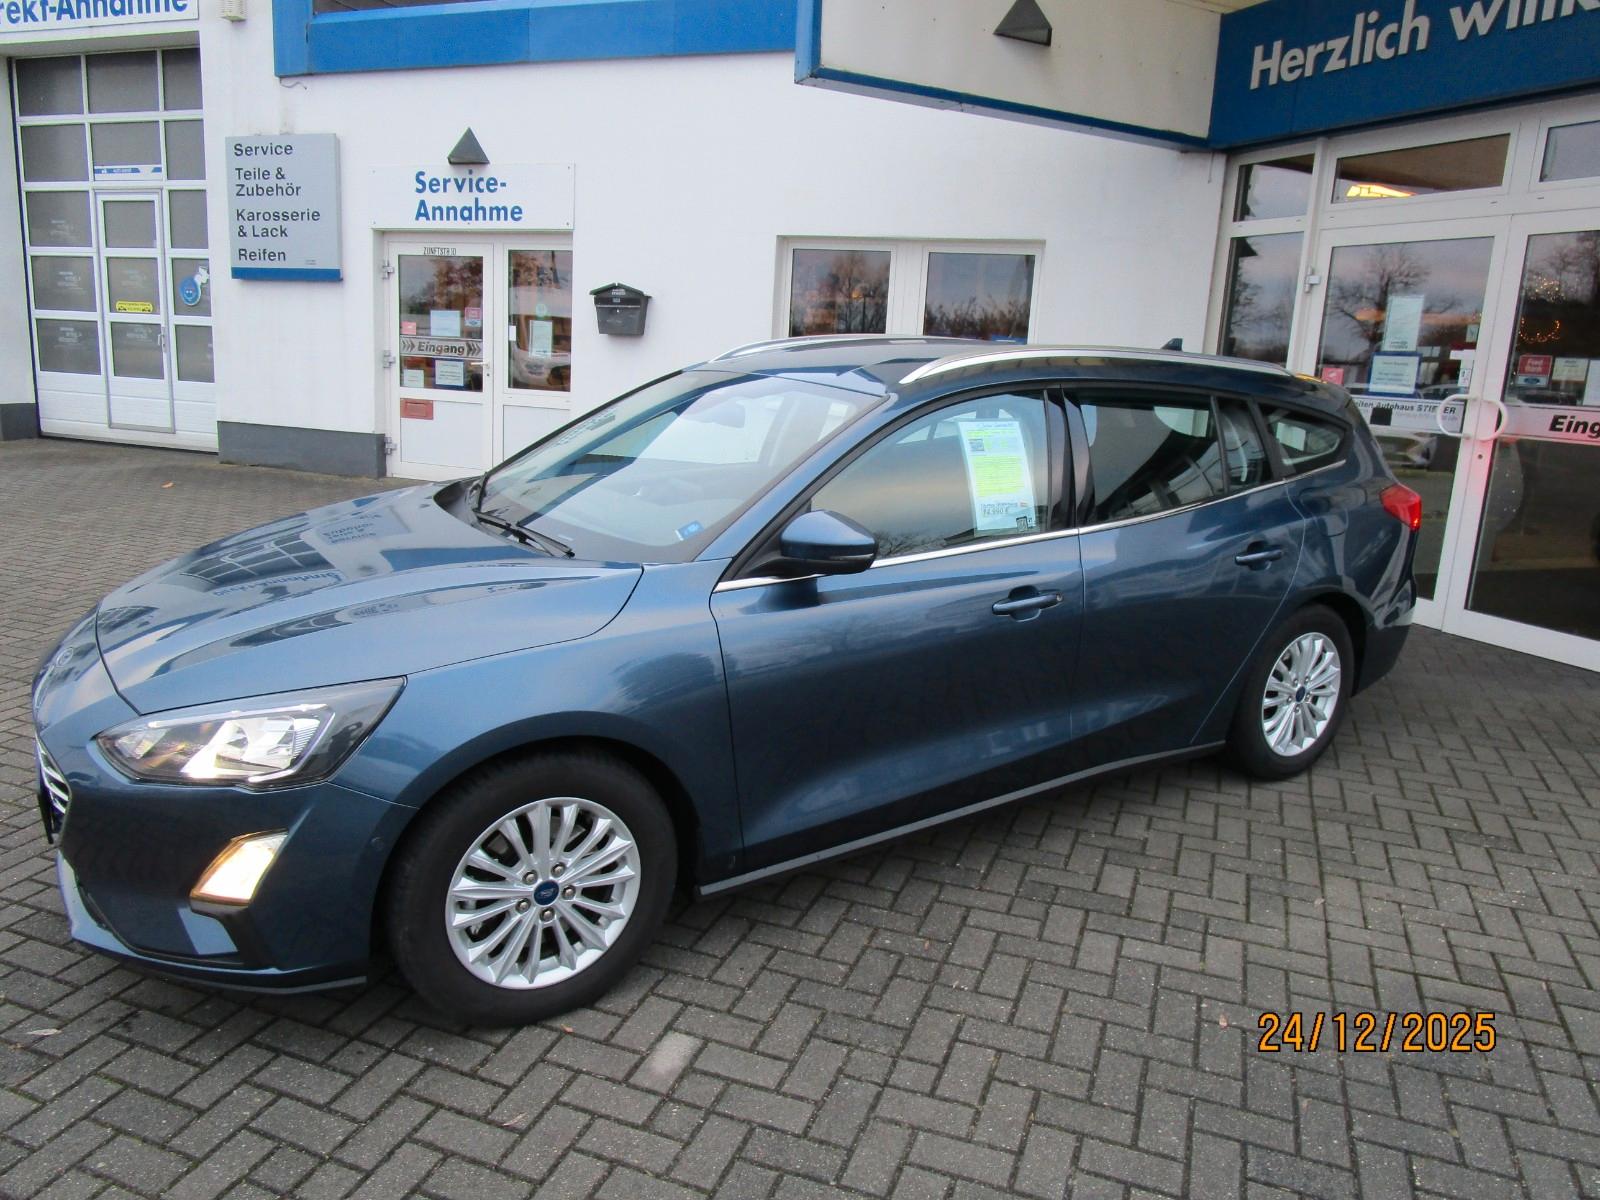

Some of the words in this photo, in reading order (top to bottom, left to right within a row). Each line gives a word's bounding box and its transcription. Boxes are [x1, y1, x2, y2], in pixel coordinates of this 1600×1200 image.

[1250, 0, 1430, 90] Herzlich
[234, 142, 293, 156] Service
[235, 167, 270, 180] Teile
[275, 167, 286, 180] &
[415, 169, 507, 194] Service-
[235, 182, 302, 196] Zubehör
[236, 208, 321, 221] Karosserie
[415, 197, 523, 222] Annahme
[238, 224, 248, 238] &
[252, 224, 288, 238] Lack
[238, 248, 286, 262] Reifen
[418, 341, 464, 356] Eingang
